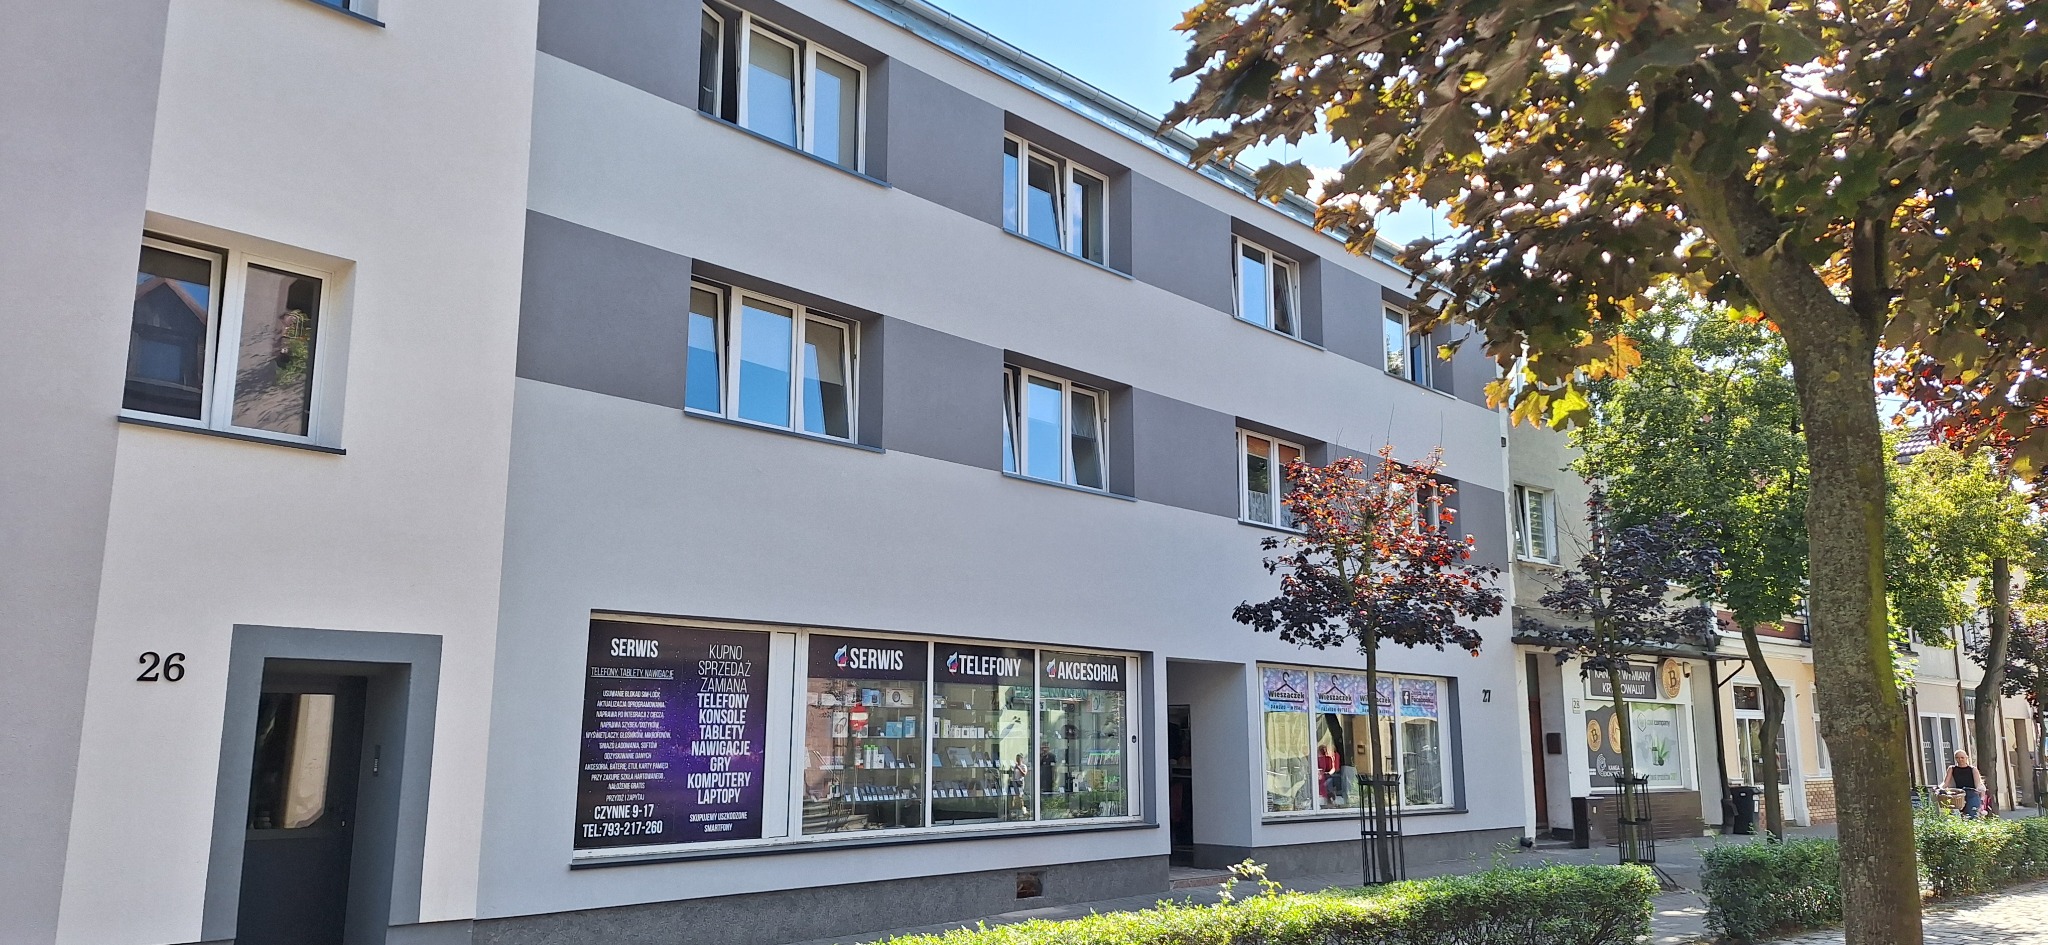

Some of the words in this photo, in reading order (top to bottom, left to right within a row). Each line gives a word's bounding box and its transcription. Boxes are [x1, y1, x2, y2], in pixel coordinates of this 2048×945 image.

[610, 637, 659, 658] SERWIS
[708, 644, 743, 660] KUPNO
[136, 651, 186, 682] 26
[849, 647, 904, 671] SERWIS
[958, 654, 1022, 677] TELEFONY
[698, 659, 752, 677] SPRZEDAŻ
[1057, 661, 1119, 683] AKCESORIA
[700, 677, 748, 693] ZAMIANA
[697, 693, 750, 709] TELEFONY
[1268, 690, 1305, 699] Wieszaczek
[1317, 692, 1352, 702] Wieszaczek
[1482, 688, 1491, 703] 27
[698, 708, 747, 725] KONSOLE
[699, 724, 745, 740] TABLETY
[691, 740, 751, 756] NAWIGACJE
[709, 756, 731, 772] GRY
[591, 773, 603, 781] PRZY
[687, 771, 752, 789] KOMPUTERY
[697, 788, 741, 805] LAPTOPY
[594, 804, 631, 820] CZYNNE
[632, 803, 655, 818] 9-17
[689, 812, 718, 822] SKUPUJEMY
[717, 811, 748, 821] USZKODZONE
[582, 820, 663, 838] TEL:793-217-260
[704, 823, 733, 833] SMARTFONY
